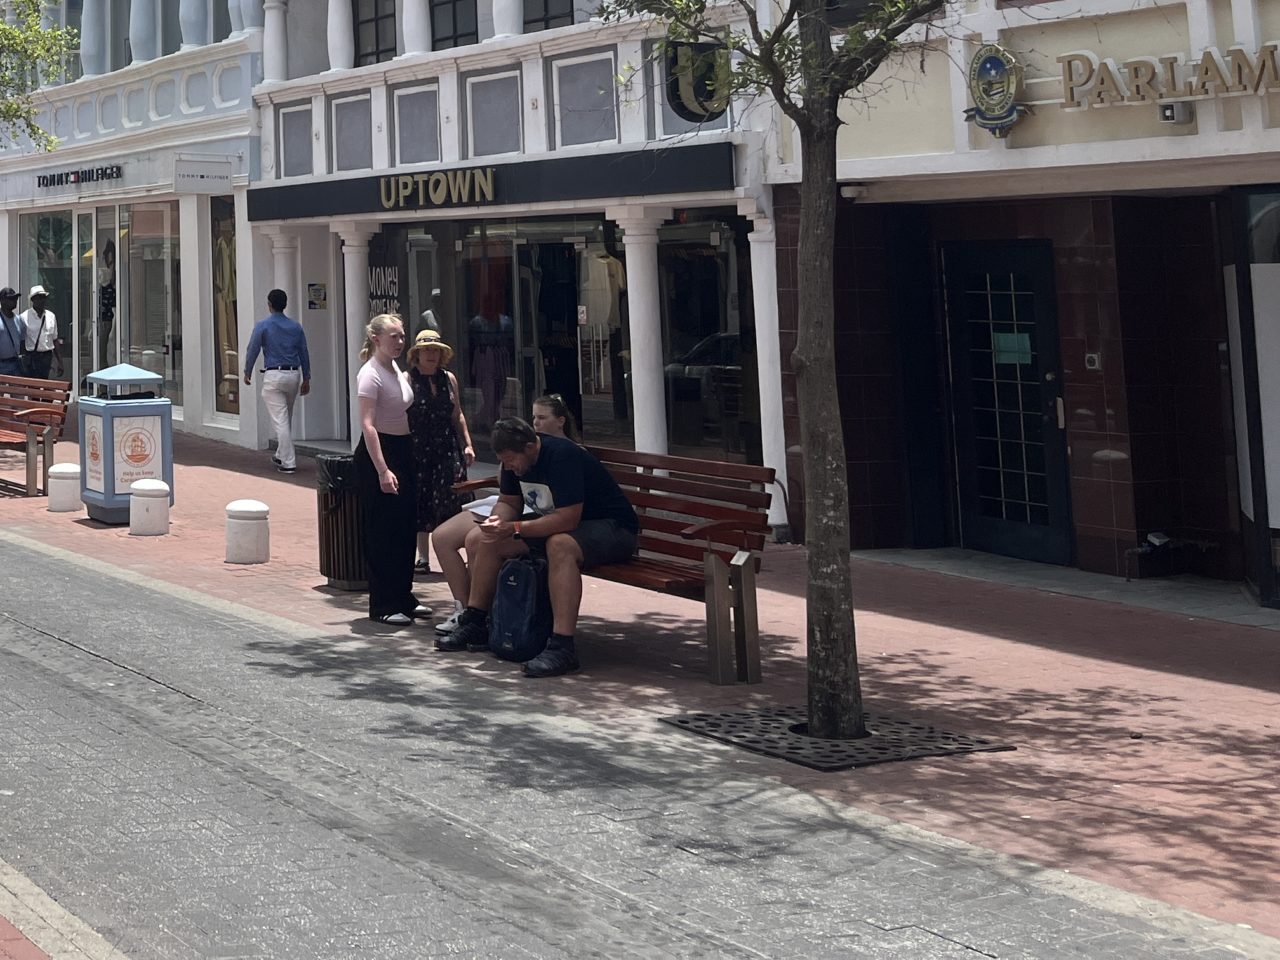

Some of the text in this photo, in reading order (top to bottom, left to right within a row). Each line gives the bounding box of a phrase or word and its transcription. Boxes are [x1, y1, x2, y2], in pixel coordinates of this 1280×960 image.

[37, 165, 123, 188] TOMMY HILFIGER
[380, 167, 494, 209] UPTOWN
